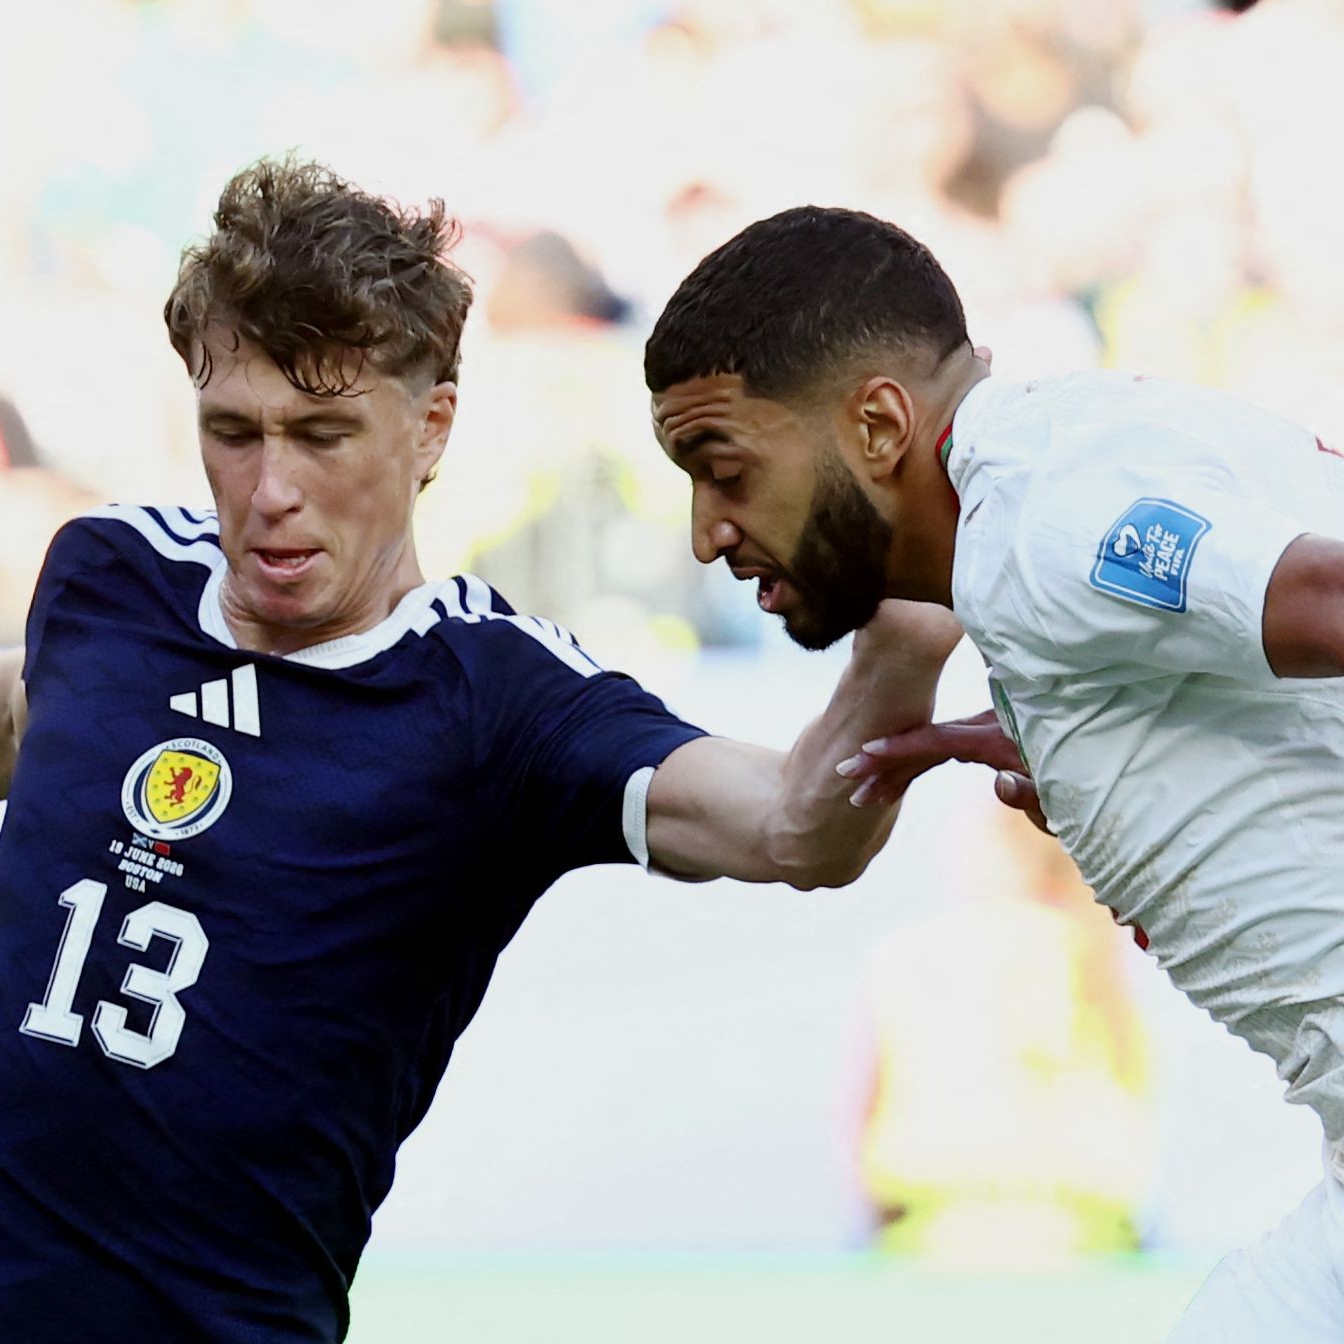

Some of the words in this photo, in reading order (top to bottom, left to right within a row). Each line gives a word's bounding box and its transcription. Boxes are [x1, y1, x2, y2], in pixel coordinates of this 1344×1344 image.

[1154, 531, 1179, 581] PEACE
[171, 740, 219, 760] SCOTLAND
[118, 859, 164, 884] BOSTON
[123, 846, 156, 866] JUNE
[156, 857, 184, 877] 2026
[125, 874, 146, 893] USA
[18, 878, 209, 1070] 13
